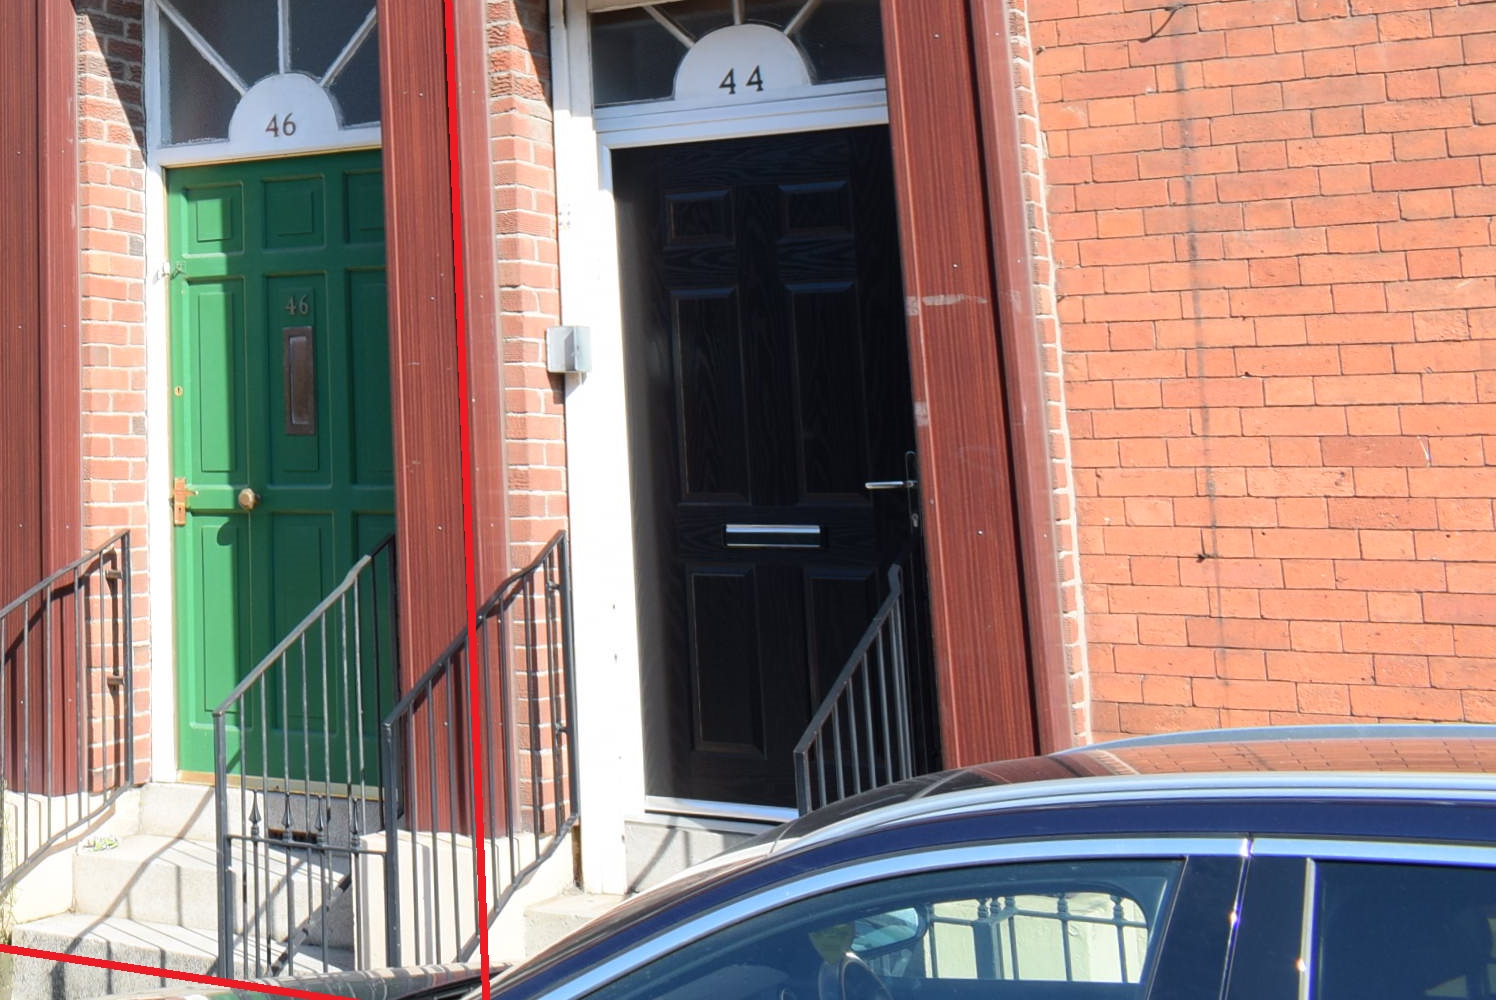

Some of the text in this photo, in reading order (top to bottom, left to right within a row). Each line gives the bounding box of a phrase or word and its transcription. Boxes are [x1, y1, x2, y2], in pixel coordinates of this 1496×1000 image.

[718, 64, 764, 95] 44
[265, 111, 297, 138] 46
[284, 295, 309, 316] 46
